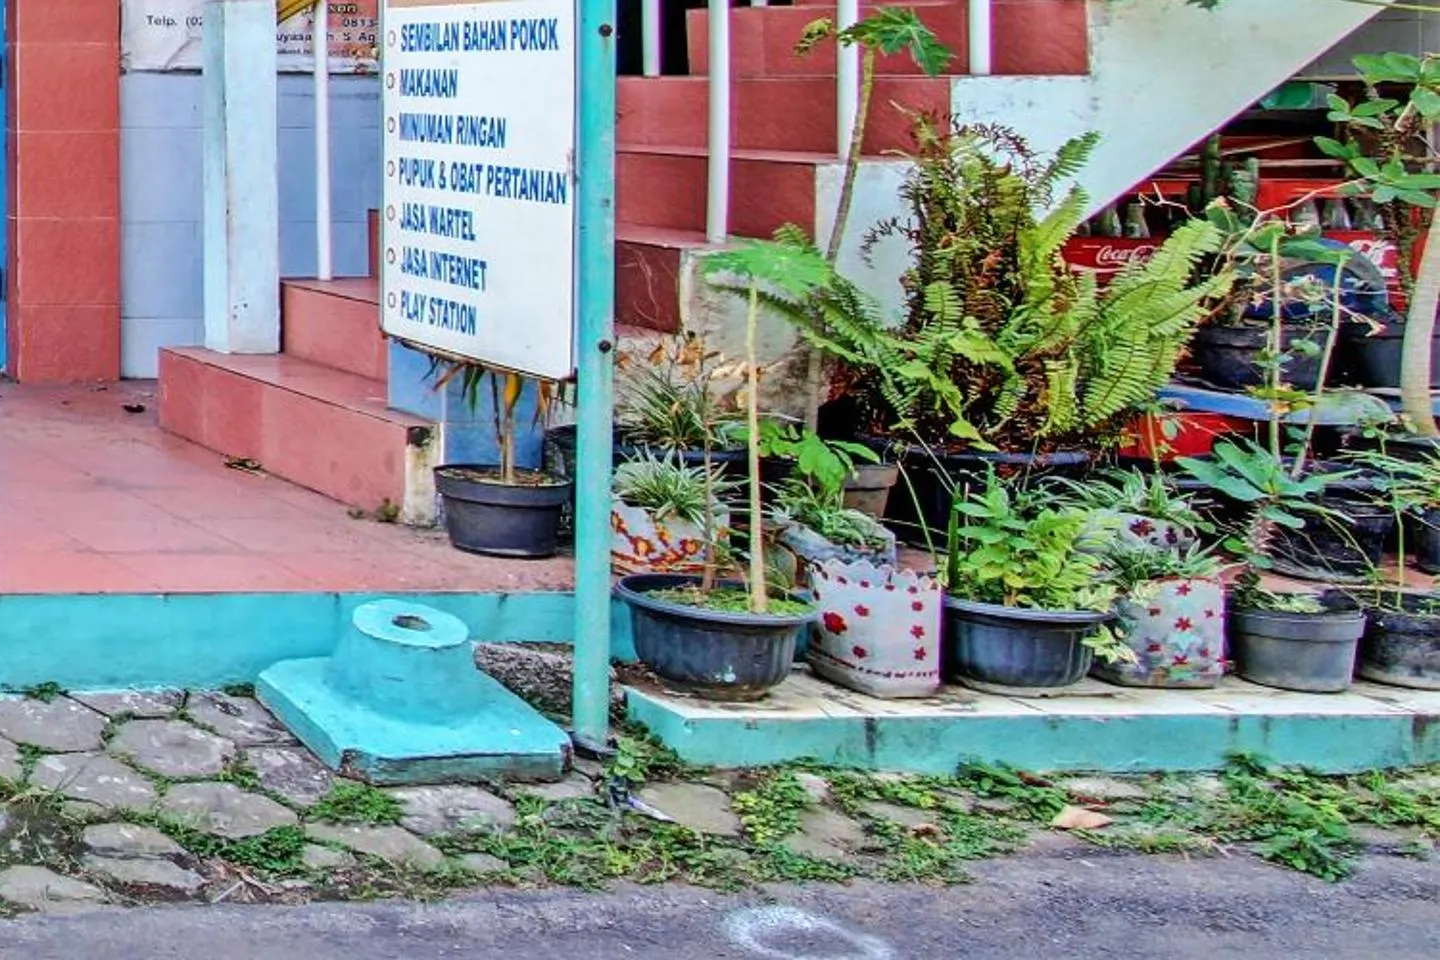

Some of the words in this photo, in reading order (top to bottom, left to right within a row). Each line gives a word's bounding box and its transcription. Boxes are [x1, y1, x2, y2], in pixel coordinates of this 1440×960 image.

[146, 15, 177, 28] Telp.
[400, 22, 460, 53] SEMBILAN
[463, 19, 507, 52] BAHAN
[510, 18, 559, 51] POKOK
[399, 68, 458, 98] MAKANAN
[399, 112, 454, 144] MINUMAN
[457, 115, 506, 149] RINGAN
[399, 156, 436, 190] PUPUK
[438, 161, 447, 192] &
[450, 162, 483, 194] OBAT
[486, 166, 567, 205] PERTANIAN
[399, 202, 427, 233] JASA
[428, 205, 476, 241] WARTEL
[401, 248, 428, 279] JASA
[429, 251, 487, 291] INTERNET
[400, 291, 427, 322] PLAY
[428, 296, 476, 336] STATION
